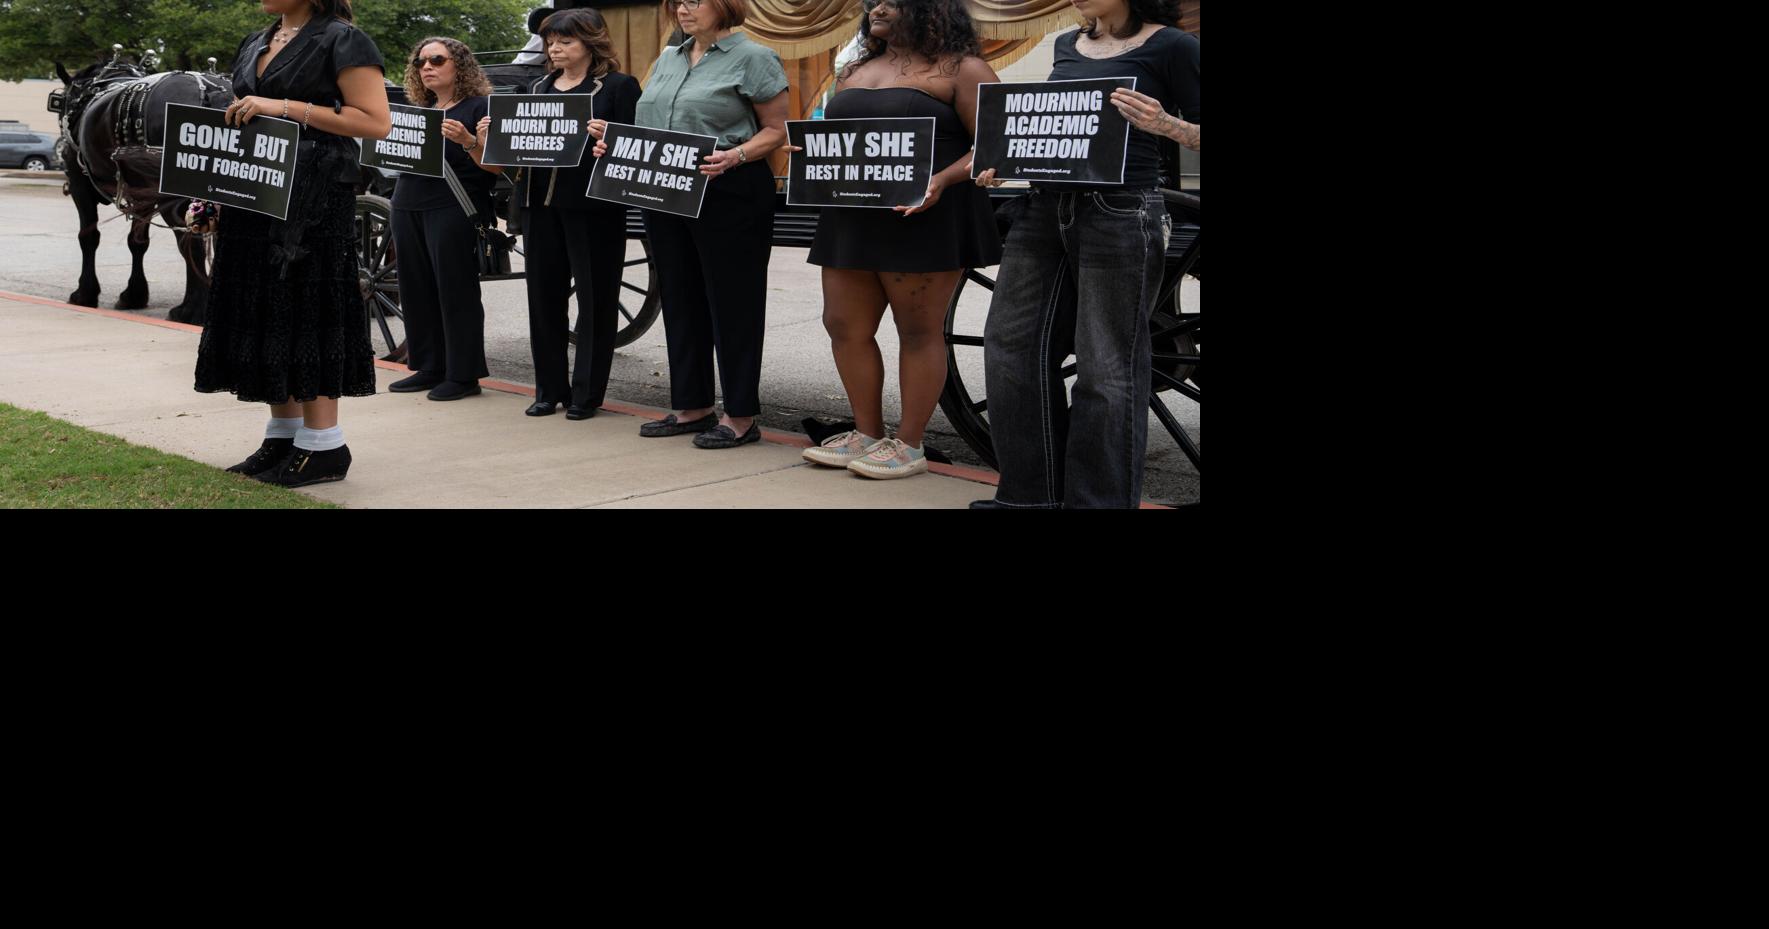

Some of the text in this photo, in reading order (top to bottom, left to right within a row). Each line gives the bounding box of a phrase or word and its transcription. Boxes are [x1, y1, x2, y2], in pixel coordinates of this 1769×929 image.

[515, 102, 564, 118] ALUMNI
[1004, 90, 1103, 113] MOURNING
[390, 111, 427, 130] URNING
[500, 118, 579, 135] MOURN OUR
[1004, 114, 1100, 136] ACADEMIC
[179, 122, 289, 163] GONE, BUT
[385, 126, 426, 145] ADEMIC
[510, 135, 565, 151] DEGREES
[805, 131, 915, 158] MAY SHE
[375, 139, 422, 160] FREEDOM
[611, 136, 700, 170] MAY SHE
[1006, 138, 1091, 159] FREEDOM
[176, 152, 286, 188] NOT FORGOTTEN
[604, 163, 694, 192] REST IN PEACE
[805, 164, 914, 181] REST IN PEACE
